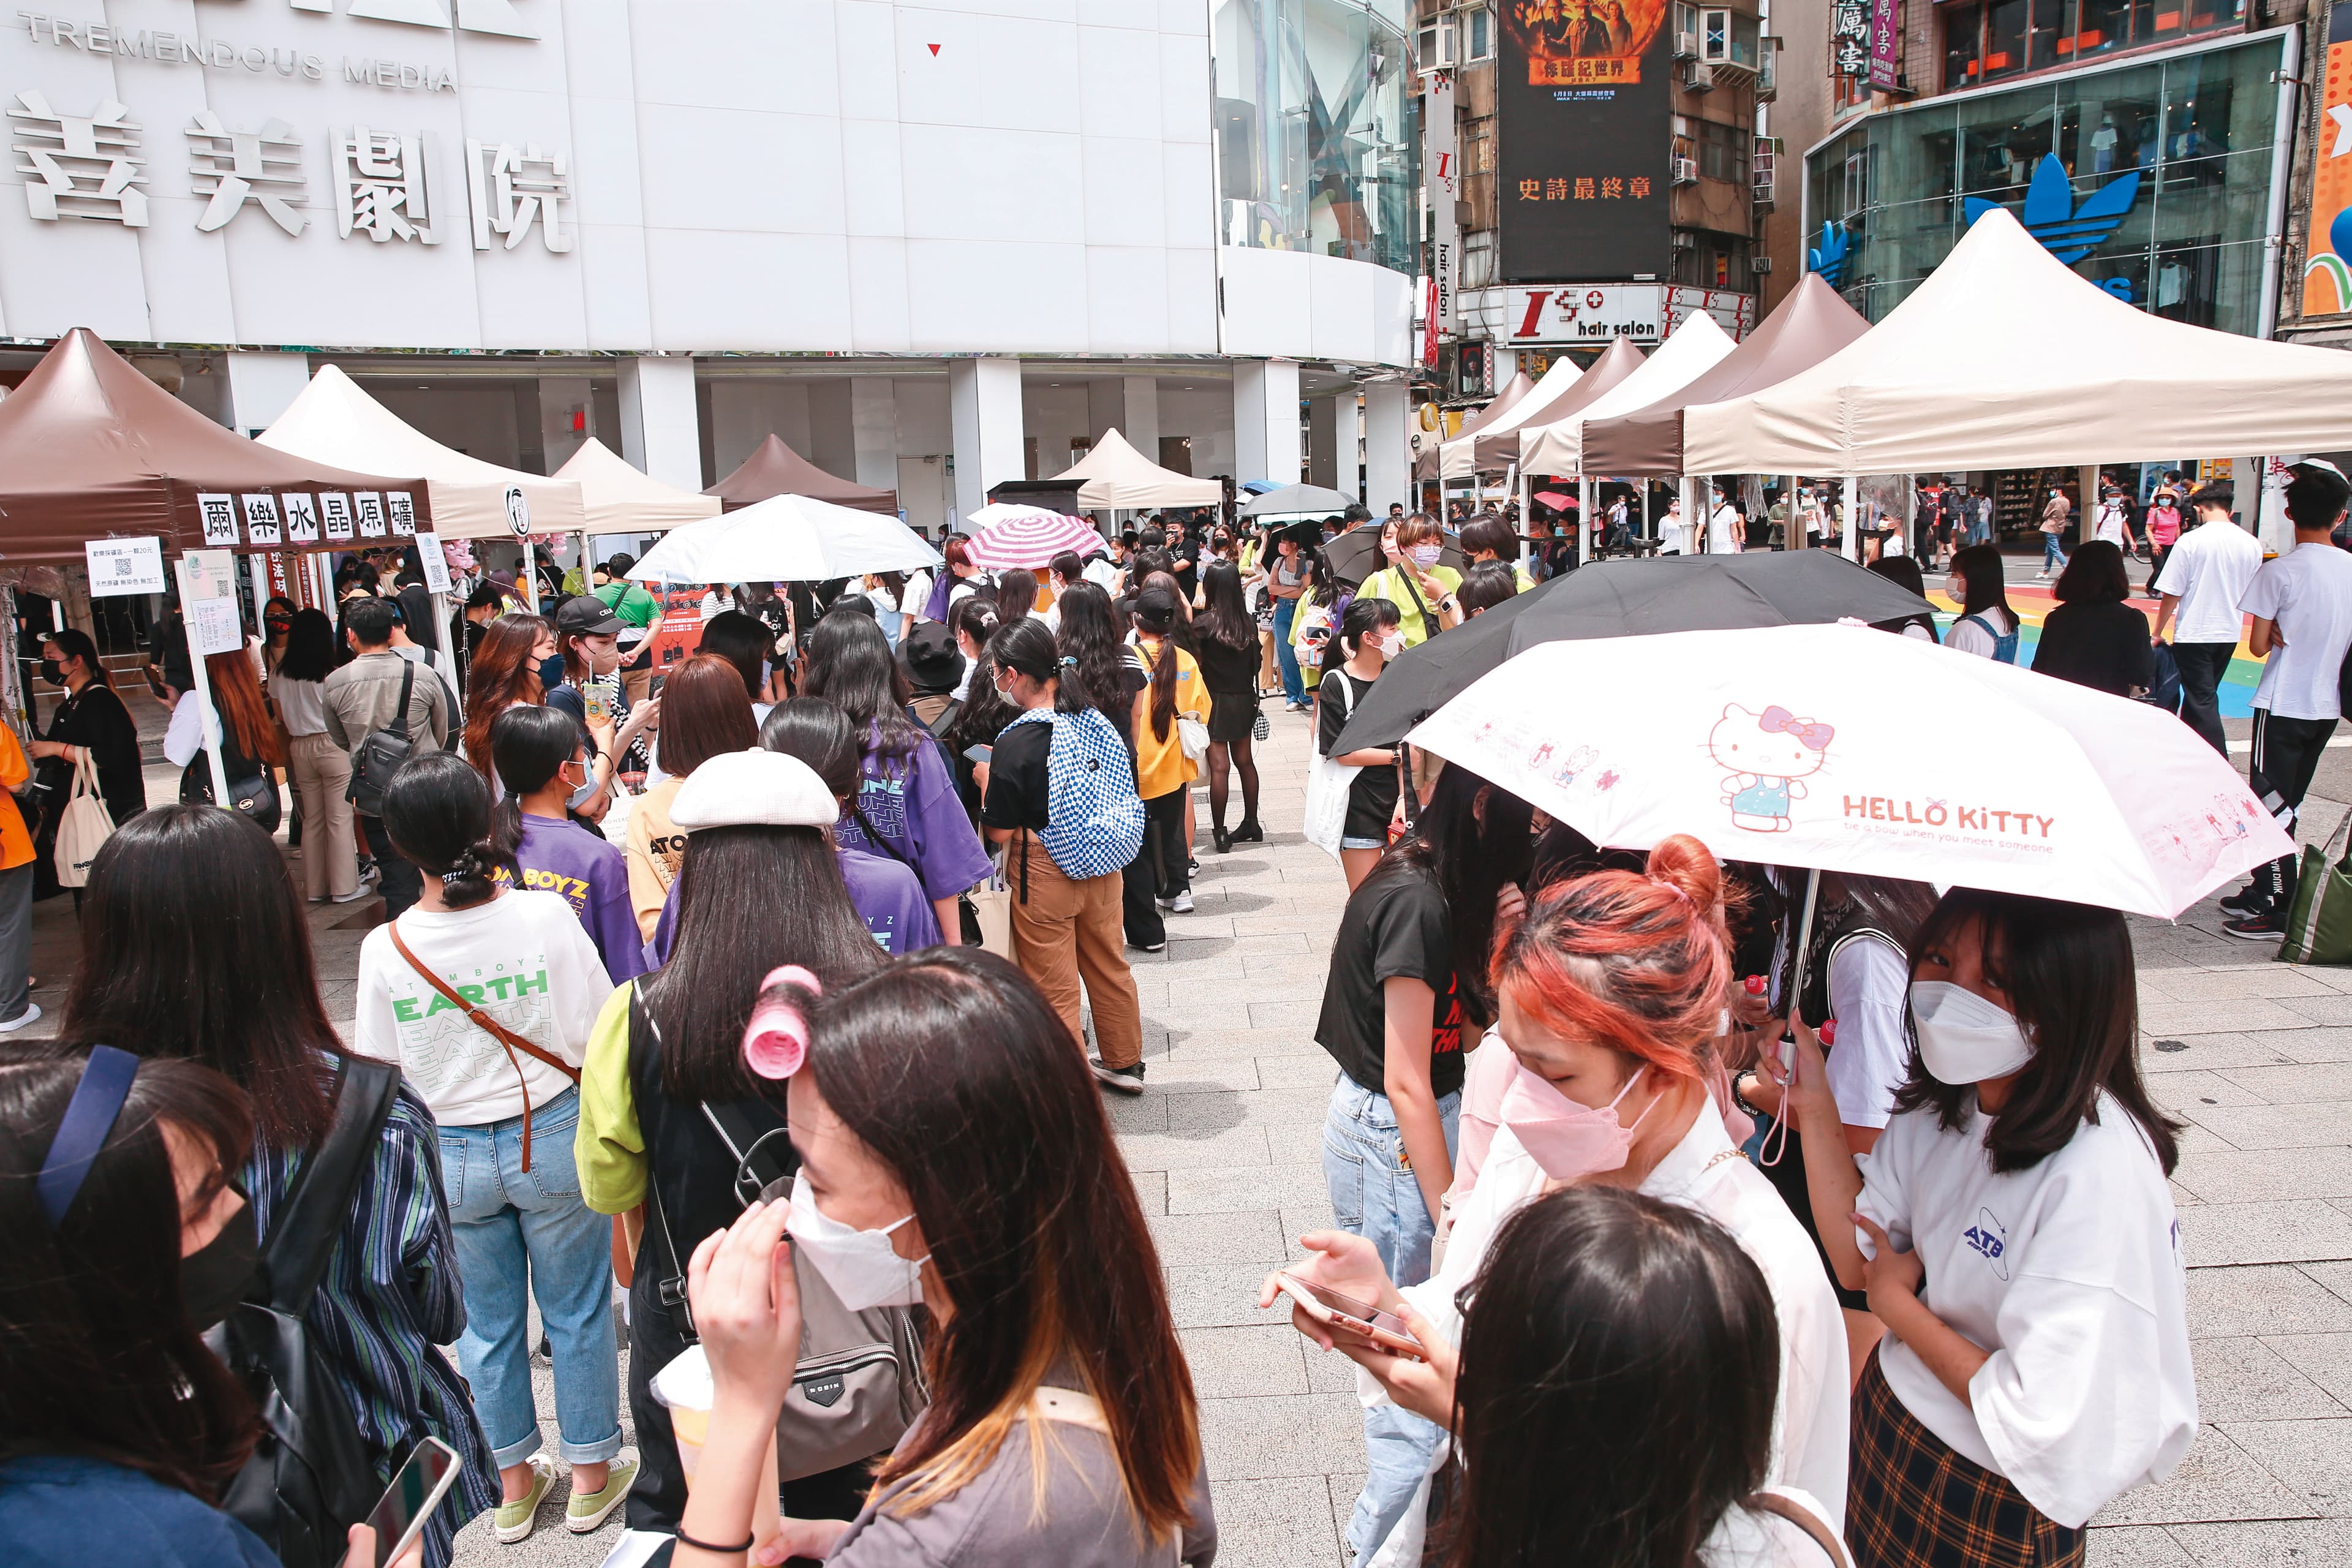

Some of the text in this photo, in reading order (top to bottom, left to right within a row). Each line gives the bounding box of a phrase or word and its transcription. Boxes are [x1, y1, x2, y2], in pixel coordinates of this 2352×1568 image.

[17, 10, 324, 80] TREMENDOUS
[344, 55, 459, 94] MEDIA
[6, 89, 573, 254] 善美劇院
[1519, 176, 1651, 201] 史詩最終章
[1440, 244, 1449, 317] hair salon
[1578, 321, 1655, 336] hair salon
[204, 497, 414, 538] 爾樂水晶原礦
[1843, 795, 1947, 826] HELLO
[1844, 821, 1859, 831] tie
[1875, 824, 1899, 835] bow
[1903, 827, 1935, 840] when
[1939, 834, 1959, 843] you
[1963, 835, 1994, 846] meet
[1999, 840, 2053, 854] someone
[523, 868, 590, 900] BOYZ
[393, 970, 548, 1022] EARTH
[1963, 1226, 2003, 1258] ATB
[809, 1382, 839, 1393] ROBIN
